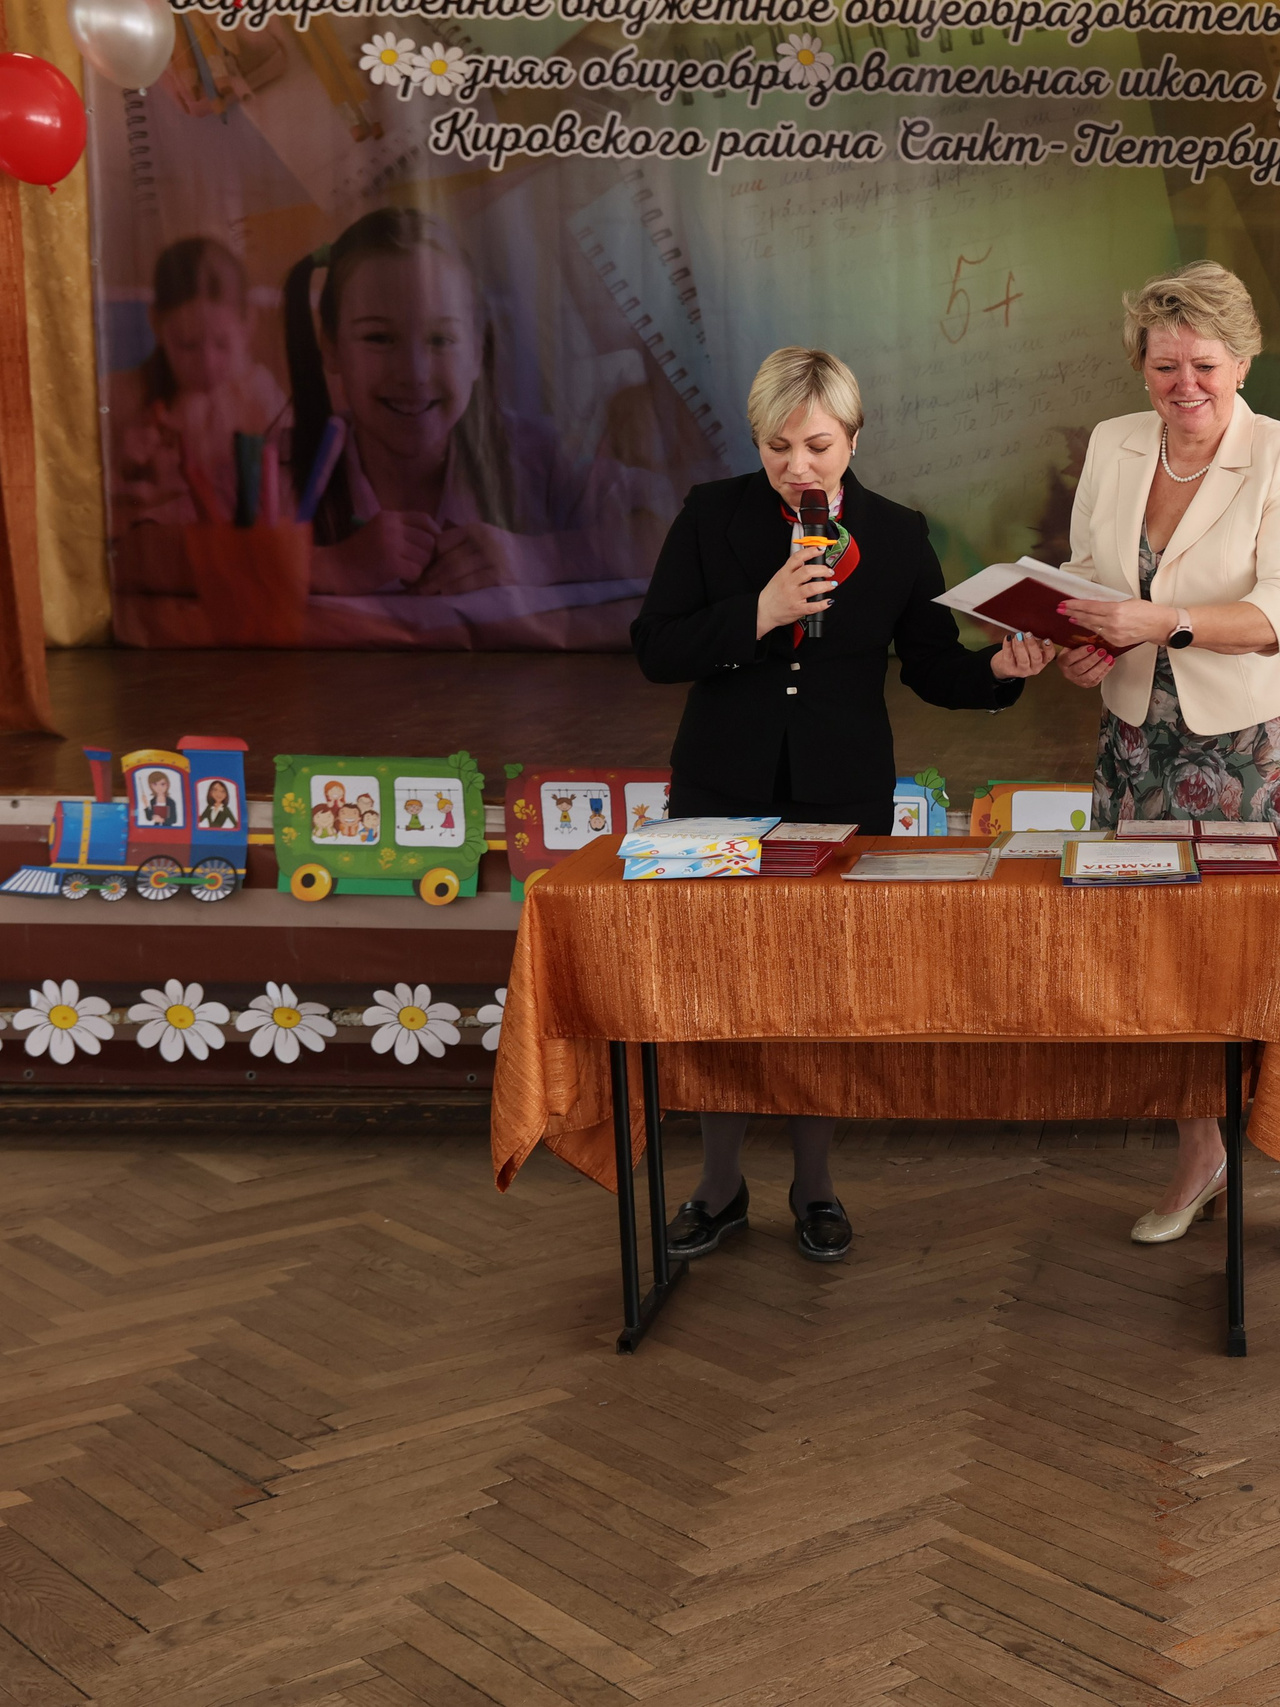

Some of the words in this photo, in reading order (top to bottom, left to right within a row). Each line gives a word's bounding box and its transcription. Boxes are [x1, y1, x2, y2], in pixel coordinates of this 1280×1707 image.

[1120, 55, 1263, 100] школа
[431, 111, 705, 168] Кировского
[710, 123, 886, 173] района
[1083, 863, 1172, 871] ГРАМОТА
